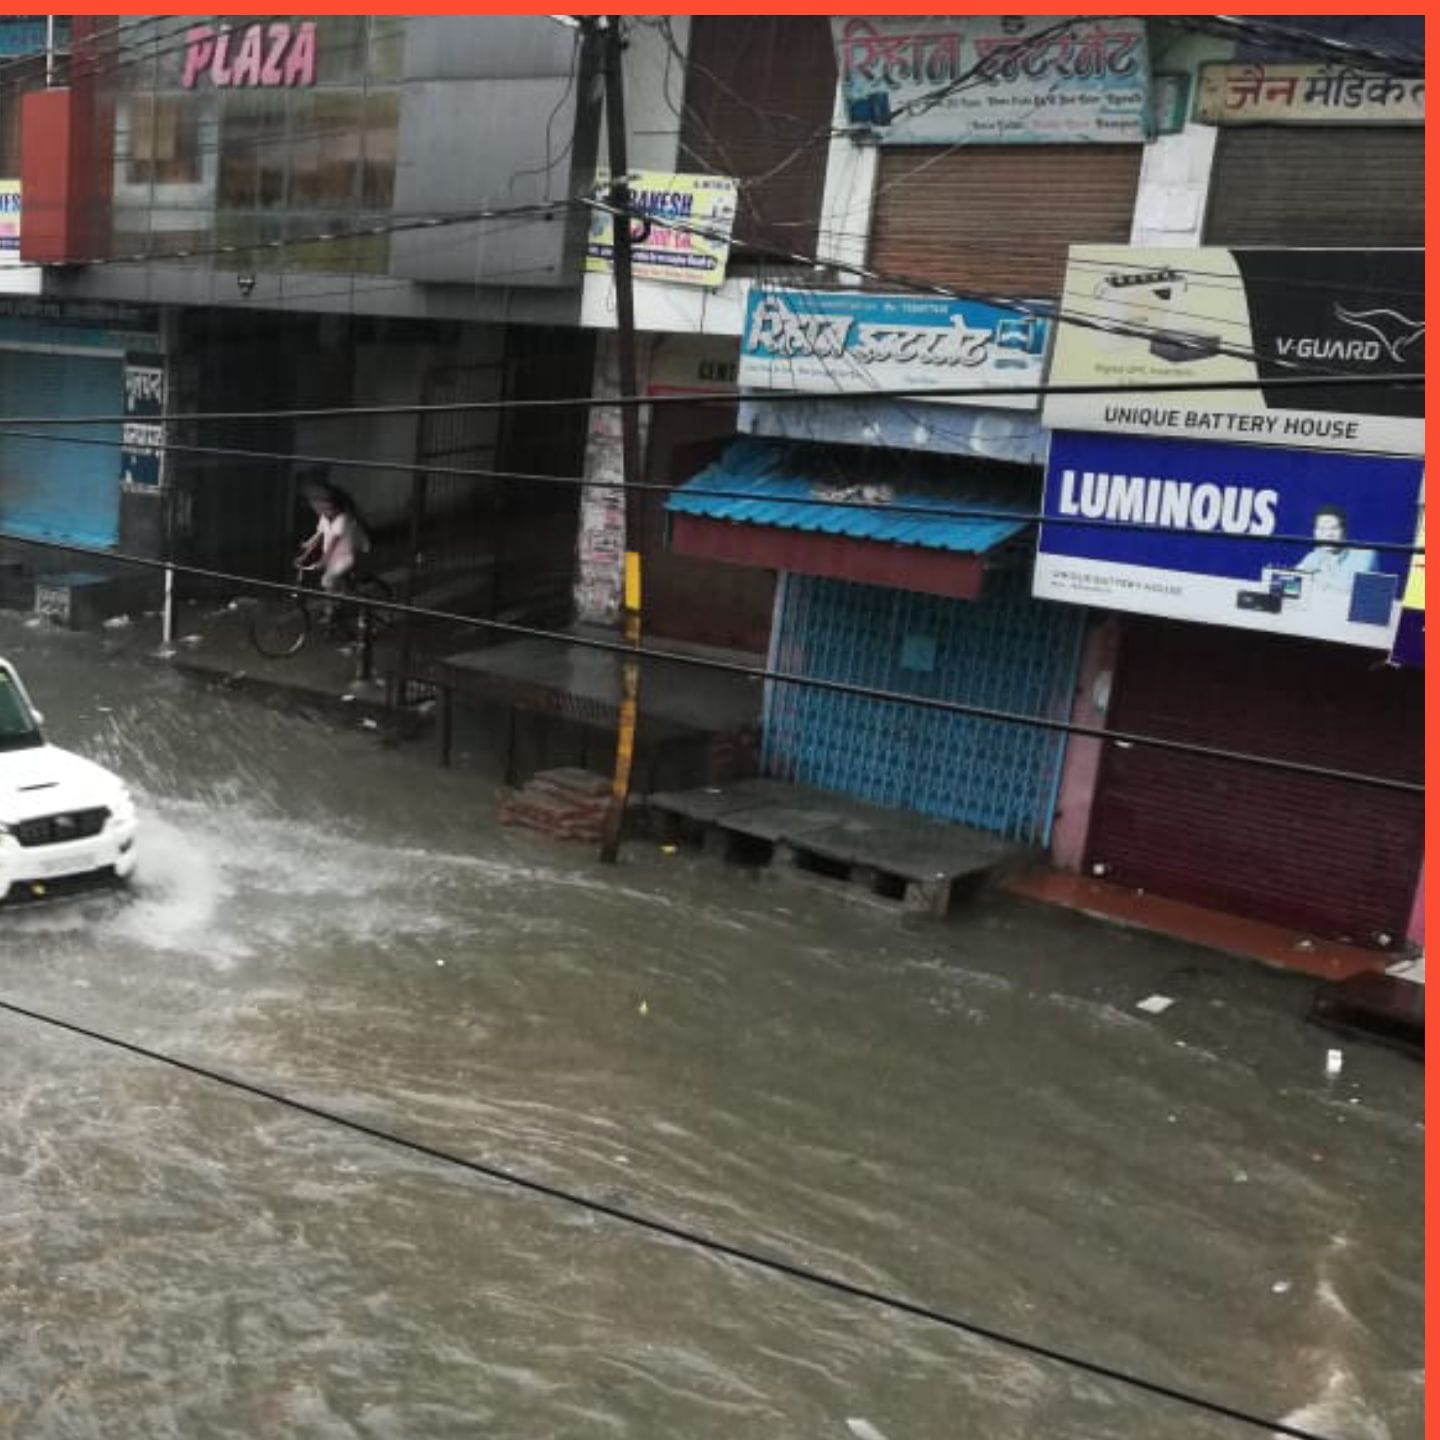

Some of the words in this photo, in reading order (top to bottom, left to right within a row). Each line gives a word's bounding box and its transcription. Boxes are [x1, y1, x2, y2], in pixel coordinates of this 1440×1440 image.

[181, 22, 317, 89] PLAZA
[1225, 64, 1298, 110] जैन
[1275, 337, 1380, 361] V-GUARD
[1104, 406, 1180, 428] UNIQUE
[1184, 410, 1279, 434] BATTERY
[1283, 417, 1360, 439] HOUSE
[1059, 469, 1279, 536] LUMINOUS
